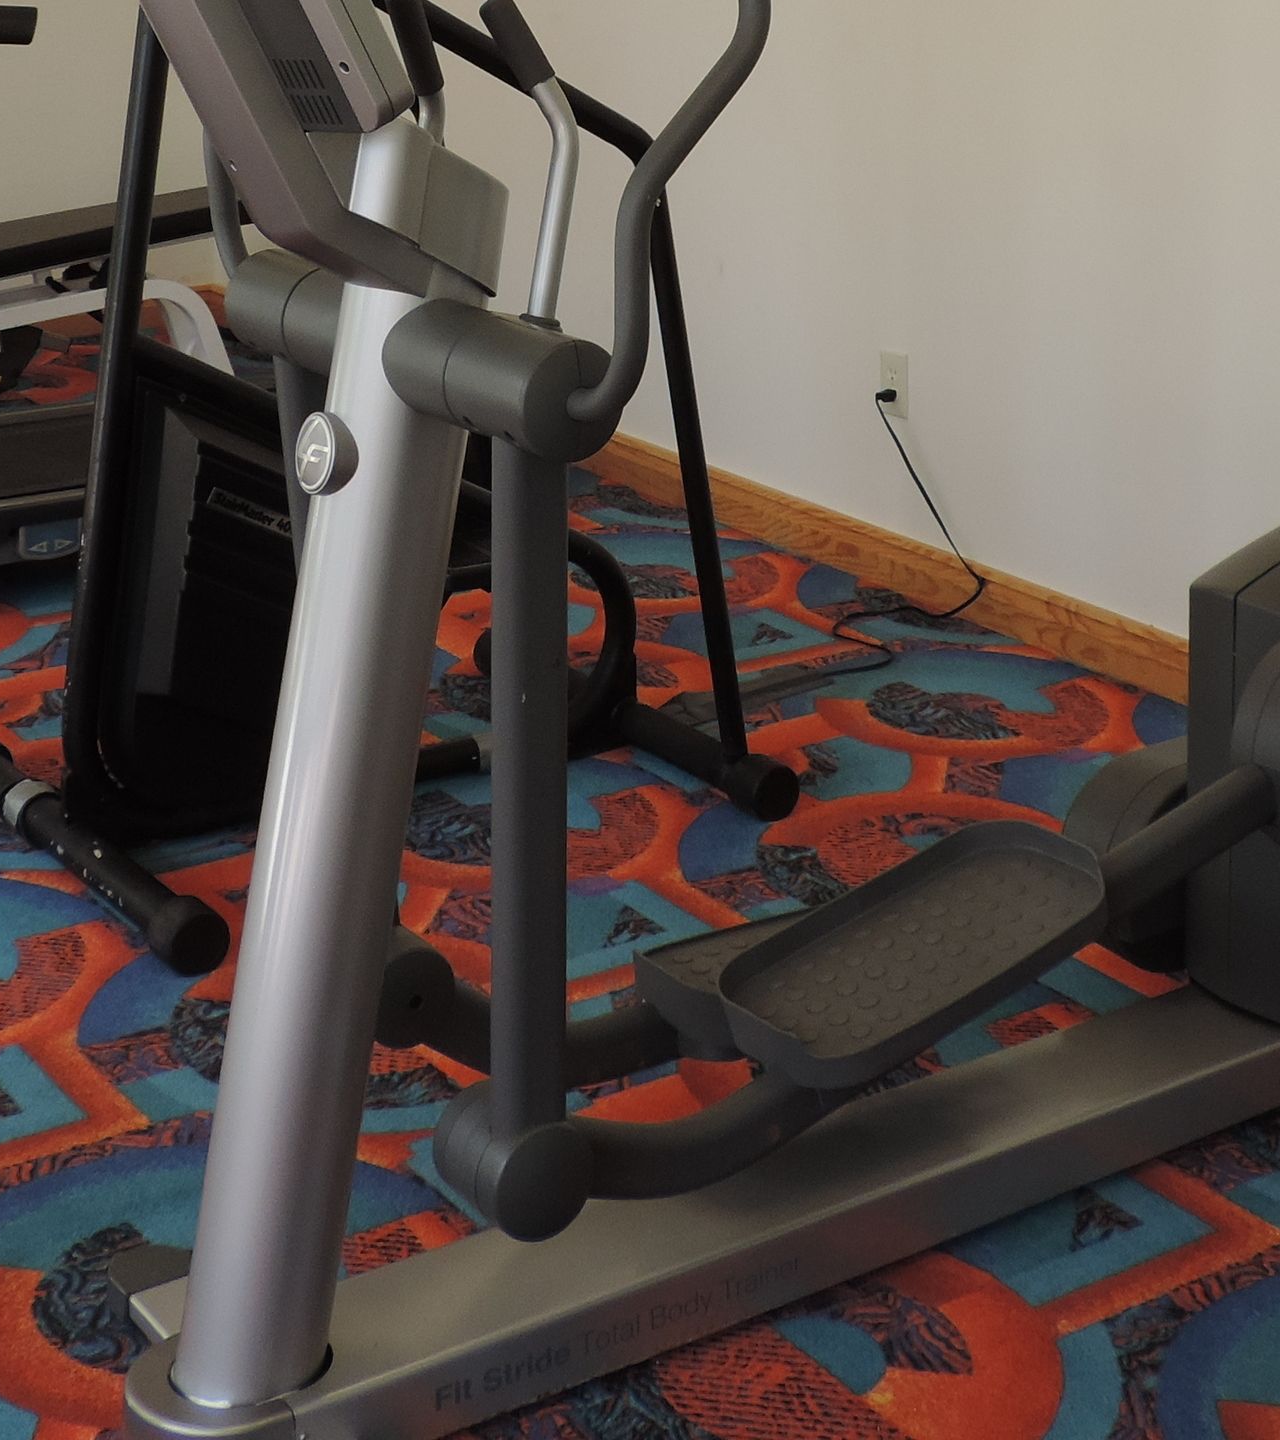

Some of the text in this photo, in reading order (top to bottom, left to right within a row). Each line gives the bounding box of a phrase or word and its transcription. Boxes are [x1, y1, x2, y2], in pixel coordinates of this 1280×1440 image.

[435, 1256, 801, 1411] Fit Stride Total Body Trainer
